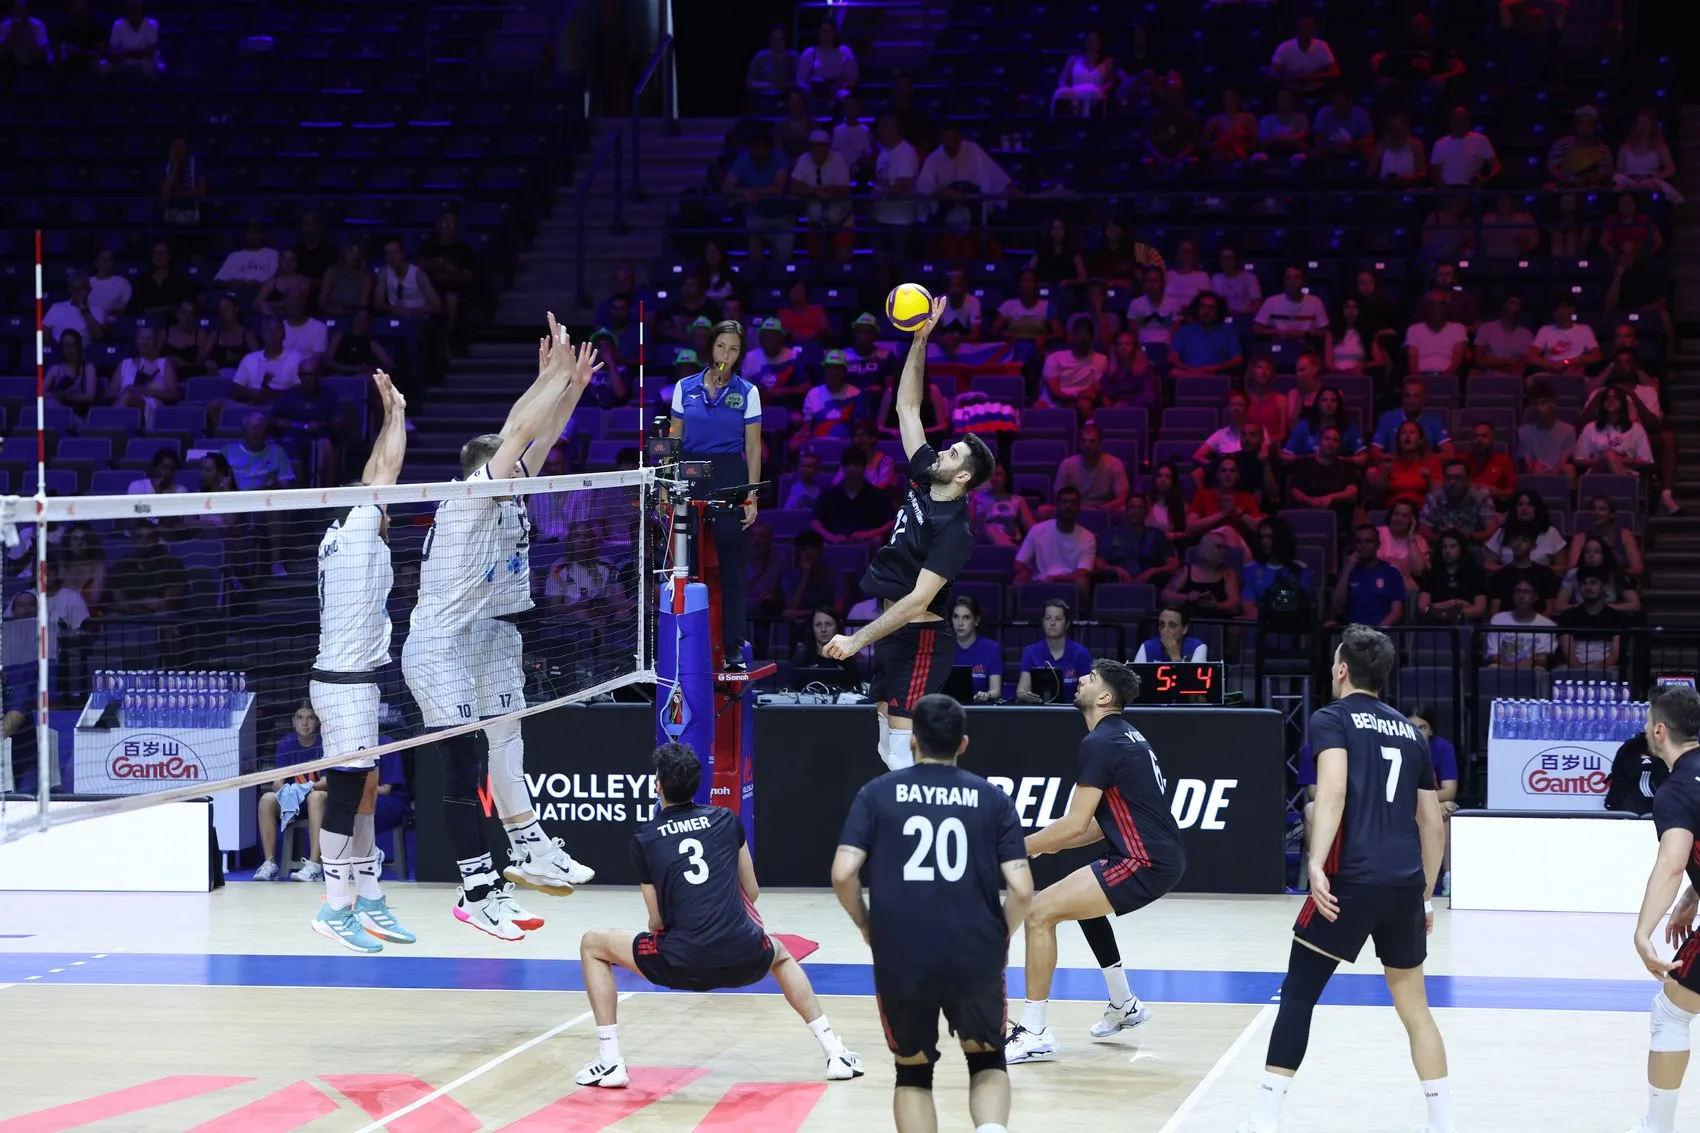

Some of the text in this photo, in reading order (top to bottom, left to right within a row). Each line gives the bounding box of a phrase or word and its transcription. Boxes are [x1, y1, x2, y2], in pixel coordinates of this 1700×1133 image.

[457, 703, 471, 718] 10
[499, 693, 512, 708] 17
[124, 741, 179, 757] 百岁山
[1541, 754, 1601, 771] 百岁山
[1380, 745, 1403, 803] 7
[1528, 769, 1612, 794] Gante
[525, 773, 658, 799] VOLLEY
[711, 787, 731, 795] noh
[896, 783, 978, 808] BAYRAM
[533, 803, 627, 822] NATIONS
[656, 816, 711, 837] TÜMER
[902, 815, 968, 882] 20
[678, 837, 709, 885] 3
